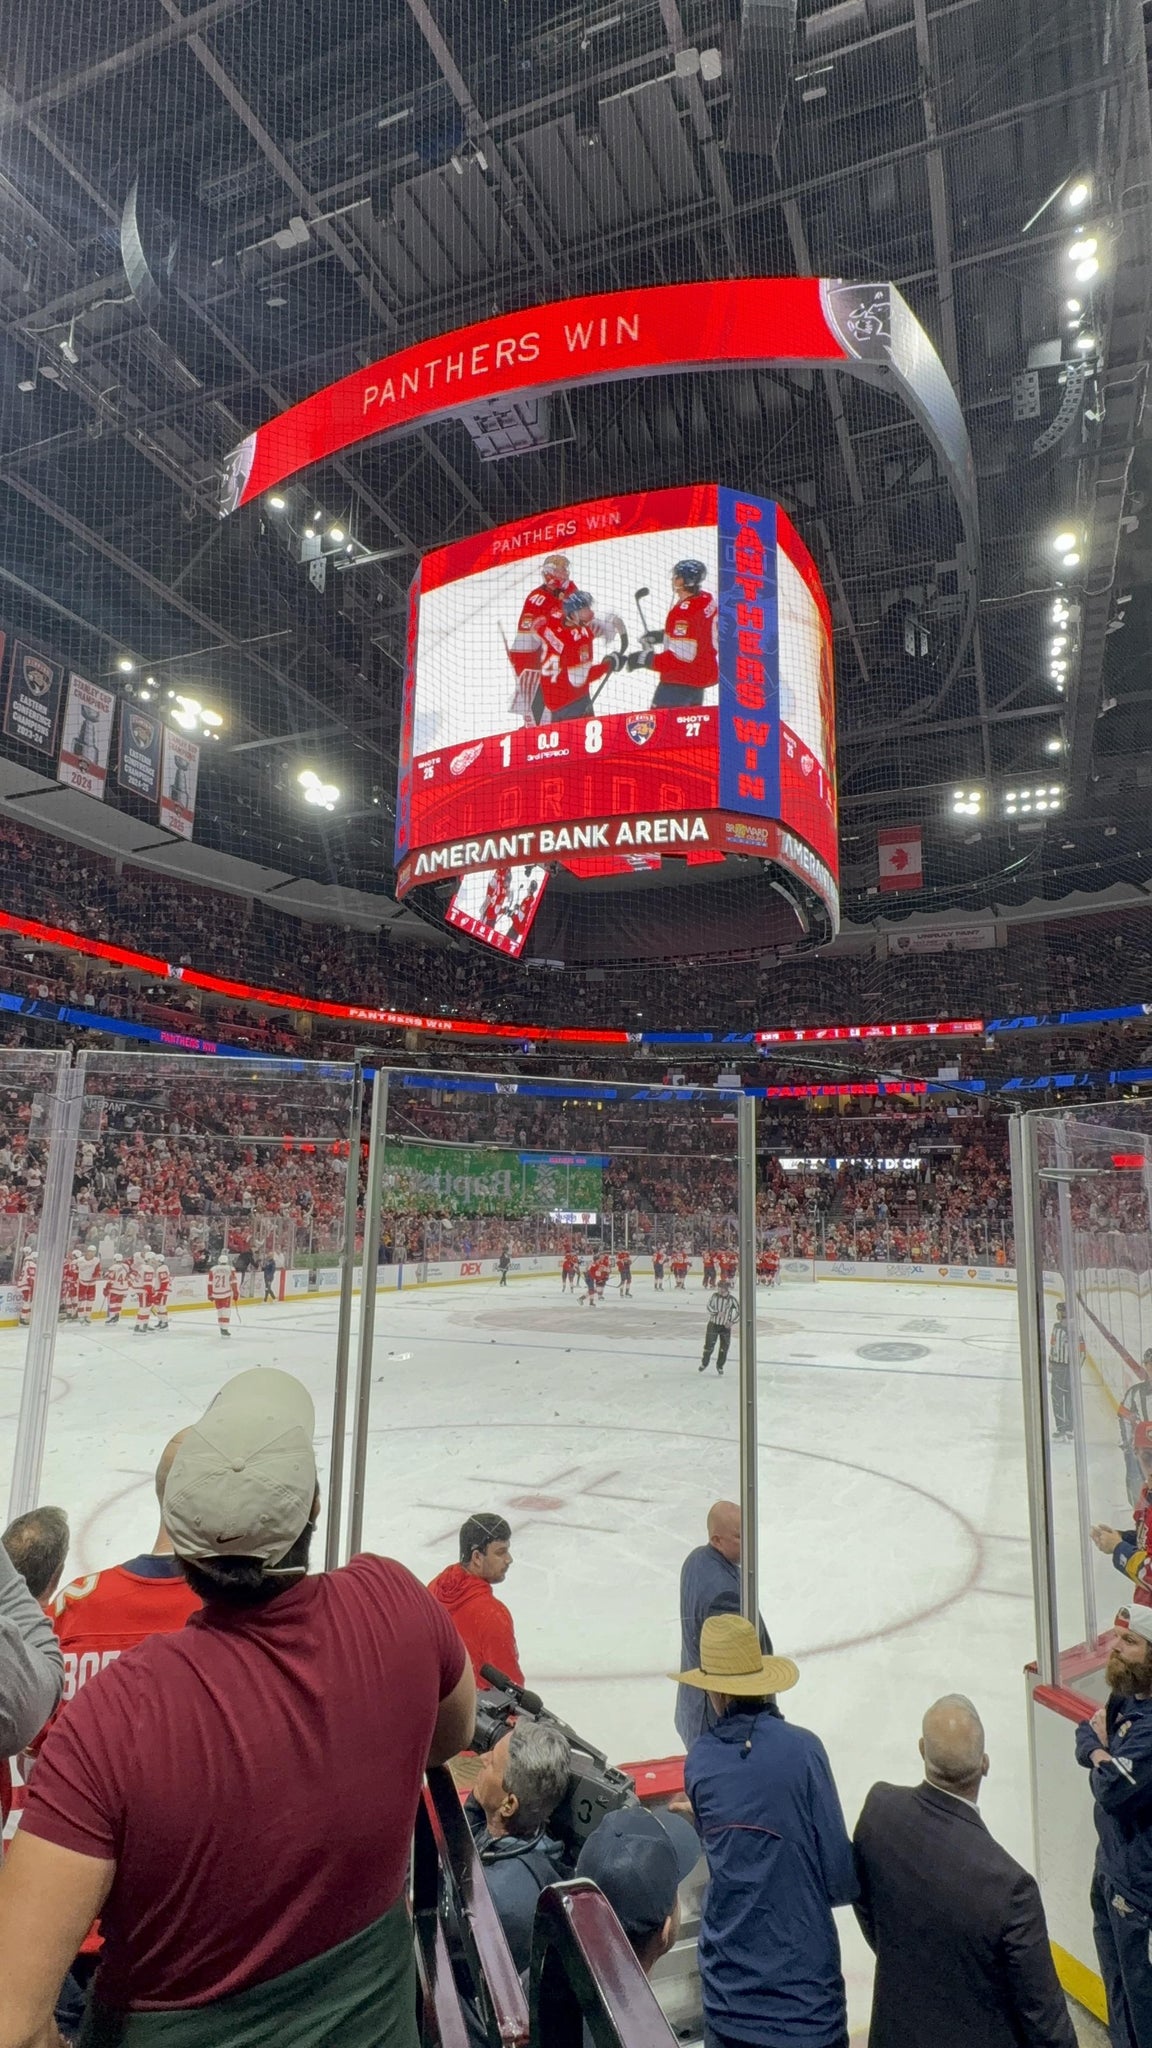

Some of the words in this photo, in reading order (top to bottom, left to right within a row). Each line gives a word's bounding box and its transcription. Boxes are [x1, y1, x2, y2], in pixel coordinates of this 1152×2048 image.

[362, 333, 540, 415] PANTHERS
[564, 314, 639, 352] WIN
[492, 520, 577, 555] PANTHERS
[586, 511, 621, 531] WIN
[734, 501, 764, 710] PANTHERS
[12, 701, 52, 728] CONFERENCE
[20, 693, 48, 715] EASTERN
[12, 711, 49, 737] CHAMPIONS
[677, 714, 710, 724] SHOTS
[686, 723, 701, 737] 27
[500, 735, 512, 768] 1
[537, 731, 560, 750] 0.0
[584, 719, 603, 753] 8
[732, 715, 771, 801] WIN
[71, 772, 92, 791] 2024
[414, 832, 535, 877] AMERANT
[539, 823, 610, 853] BANK
[615, 817, 710, 846] ARENA
[349, 1008, 423, 1027] PANTHERS
[426, 1019, 453, 1029] WIN
[161, 1031, 200, 1049] PANTHERS
[766, 1083, 880, 1097] PANTHERS
[884, 1082, 928, 1094] WIN
[460, 1263, 483, 1276] DEX
[214, 1275, 226, 1289] 21
